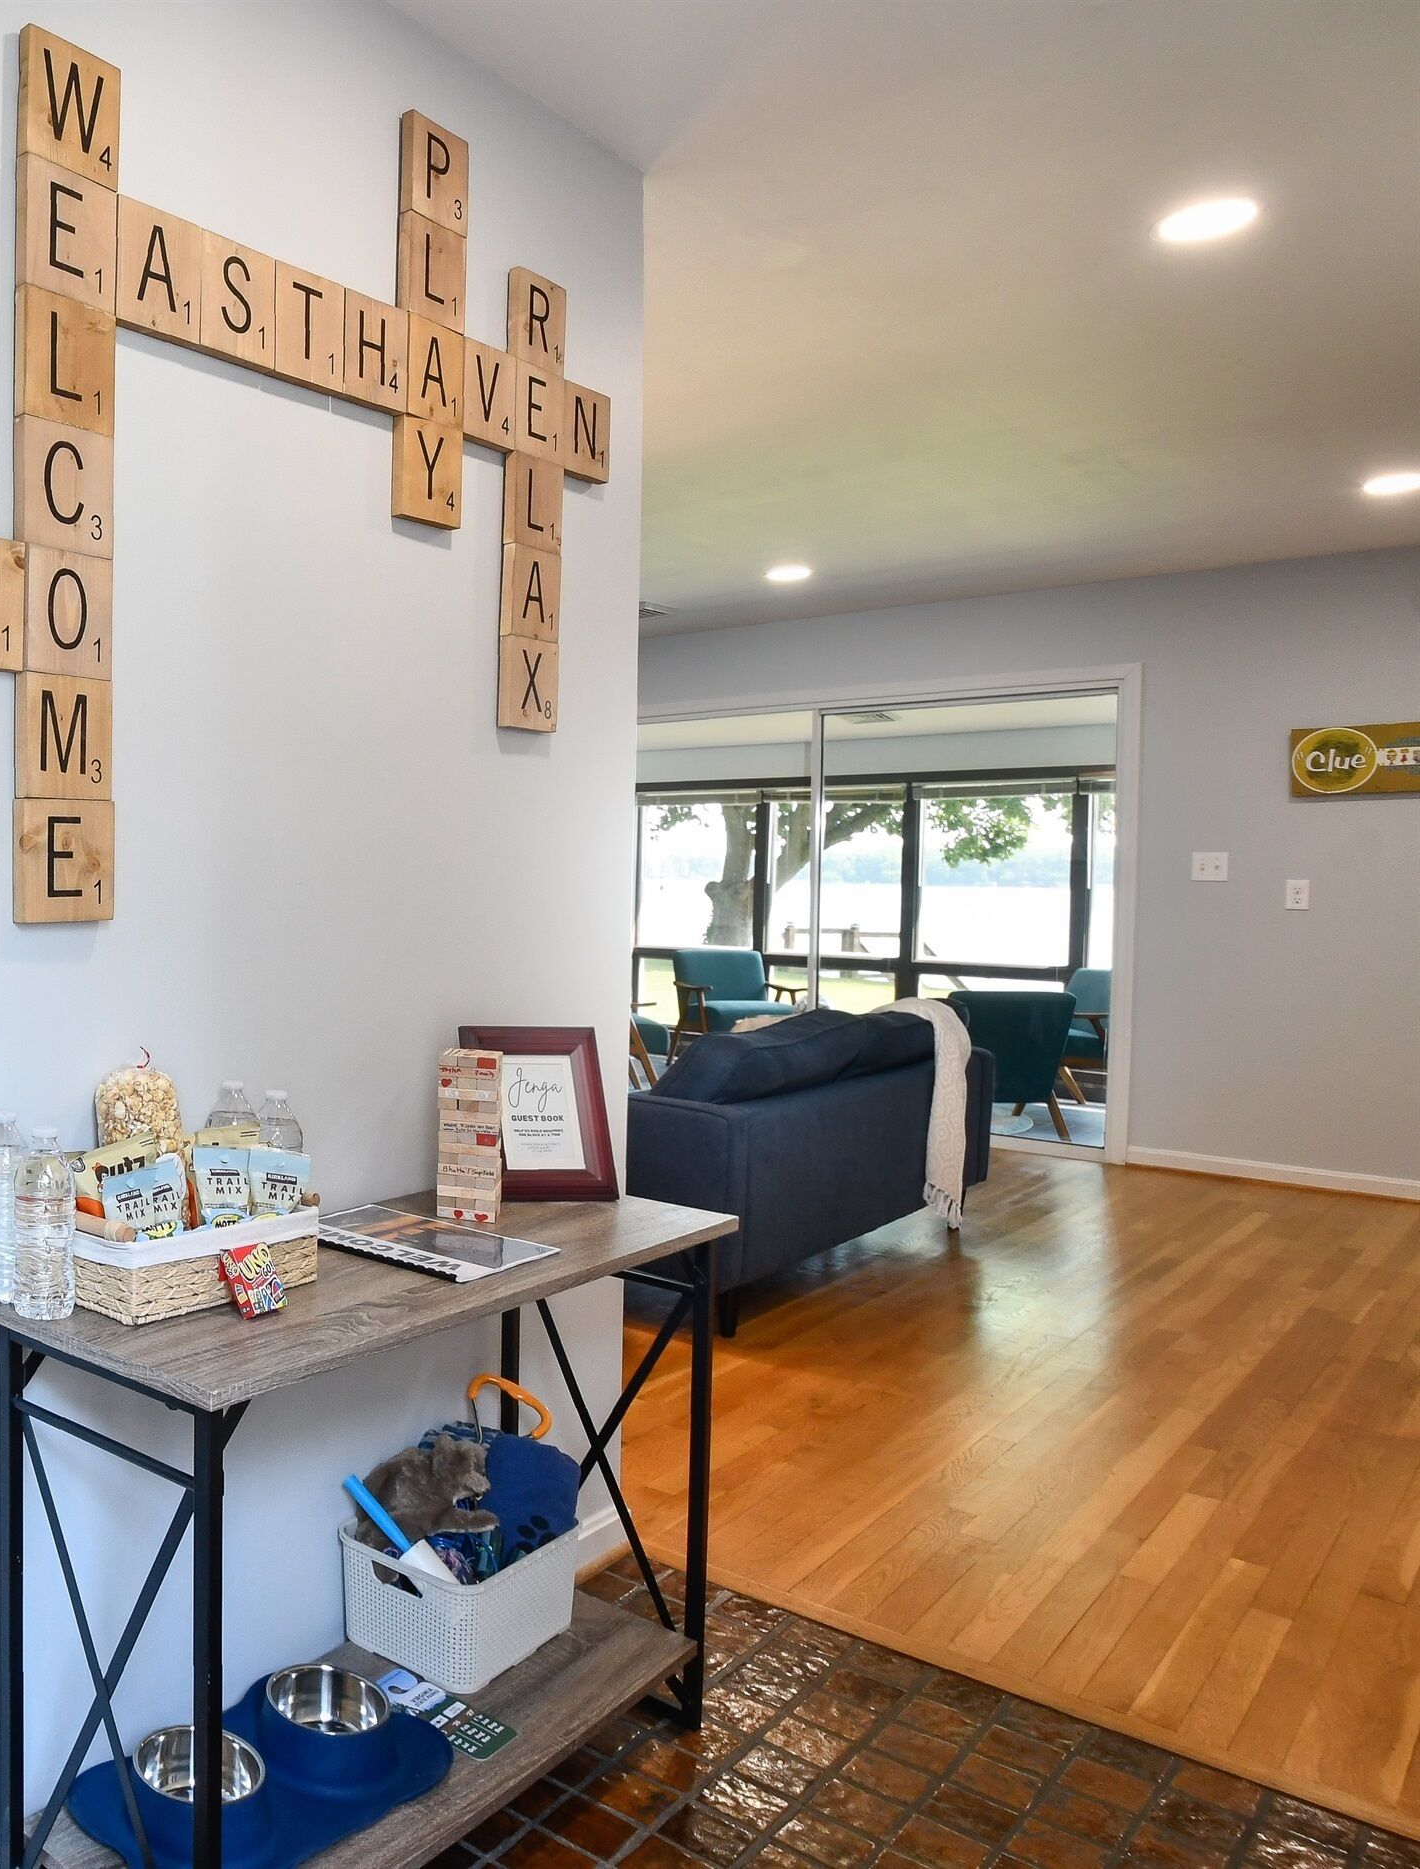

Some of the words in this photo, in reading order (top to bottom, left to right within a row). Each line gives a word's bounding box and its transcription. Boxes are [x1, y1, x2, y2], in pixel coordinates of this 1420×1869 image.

[417, 131, 451, 500] PLAY
[39, 48, 104, 898] WELCOME
[521, 284, 549, 713] RELAX
[508, 1067, 563, 1113] Jenga
[511, 1114, 539, 1122] GUEST
[540, 1114, 565, 1122] BOOK
[206, 1177, 249, 1186] TRAIL
[261, 1181, 304, 1196] TRAIL
[152, 1191, 181, 1204] RAIL
[215, 1186, 243, 1195] MIX
[267, 1191, 296, 1202] MIX
[116, 1198, 151, 1213] TRAIL
[153, 1202, 179, 1214] MIX
[125, 1208, 146, 1221] MIX
[238, 1243, 270, 1282] UNO
[262, 1260, 275, 1277] GO!
